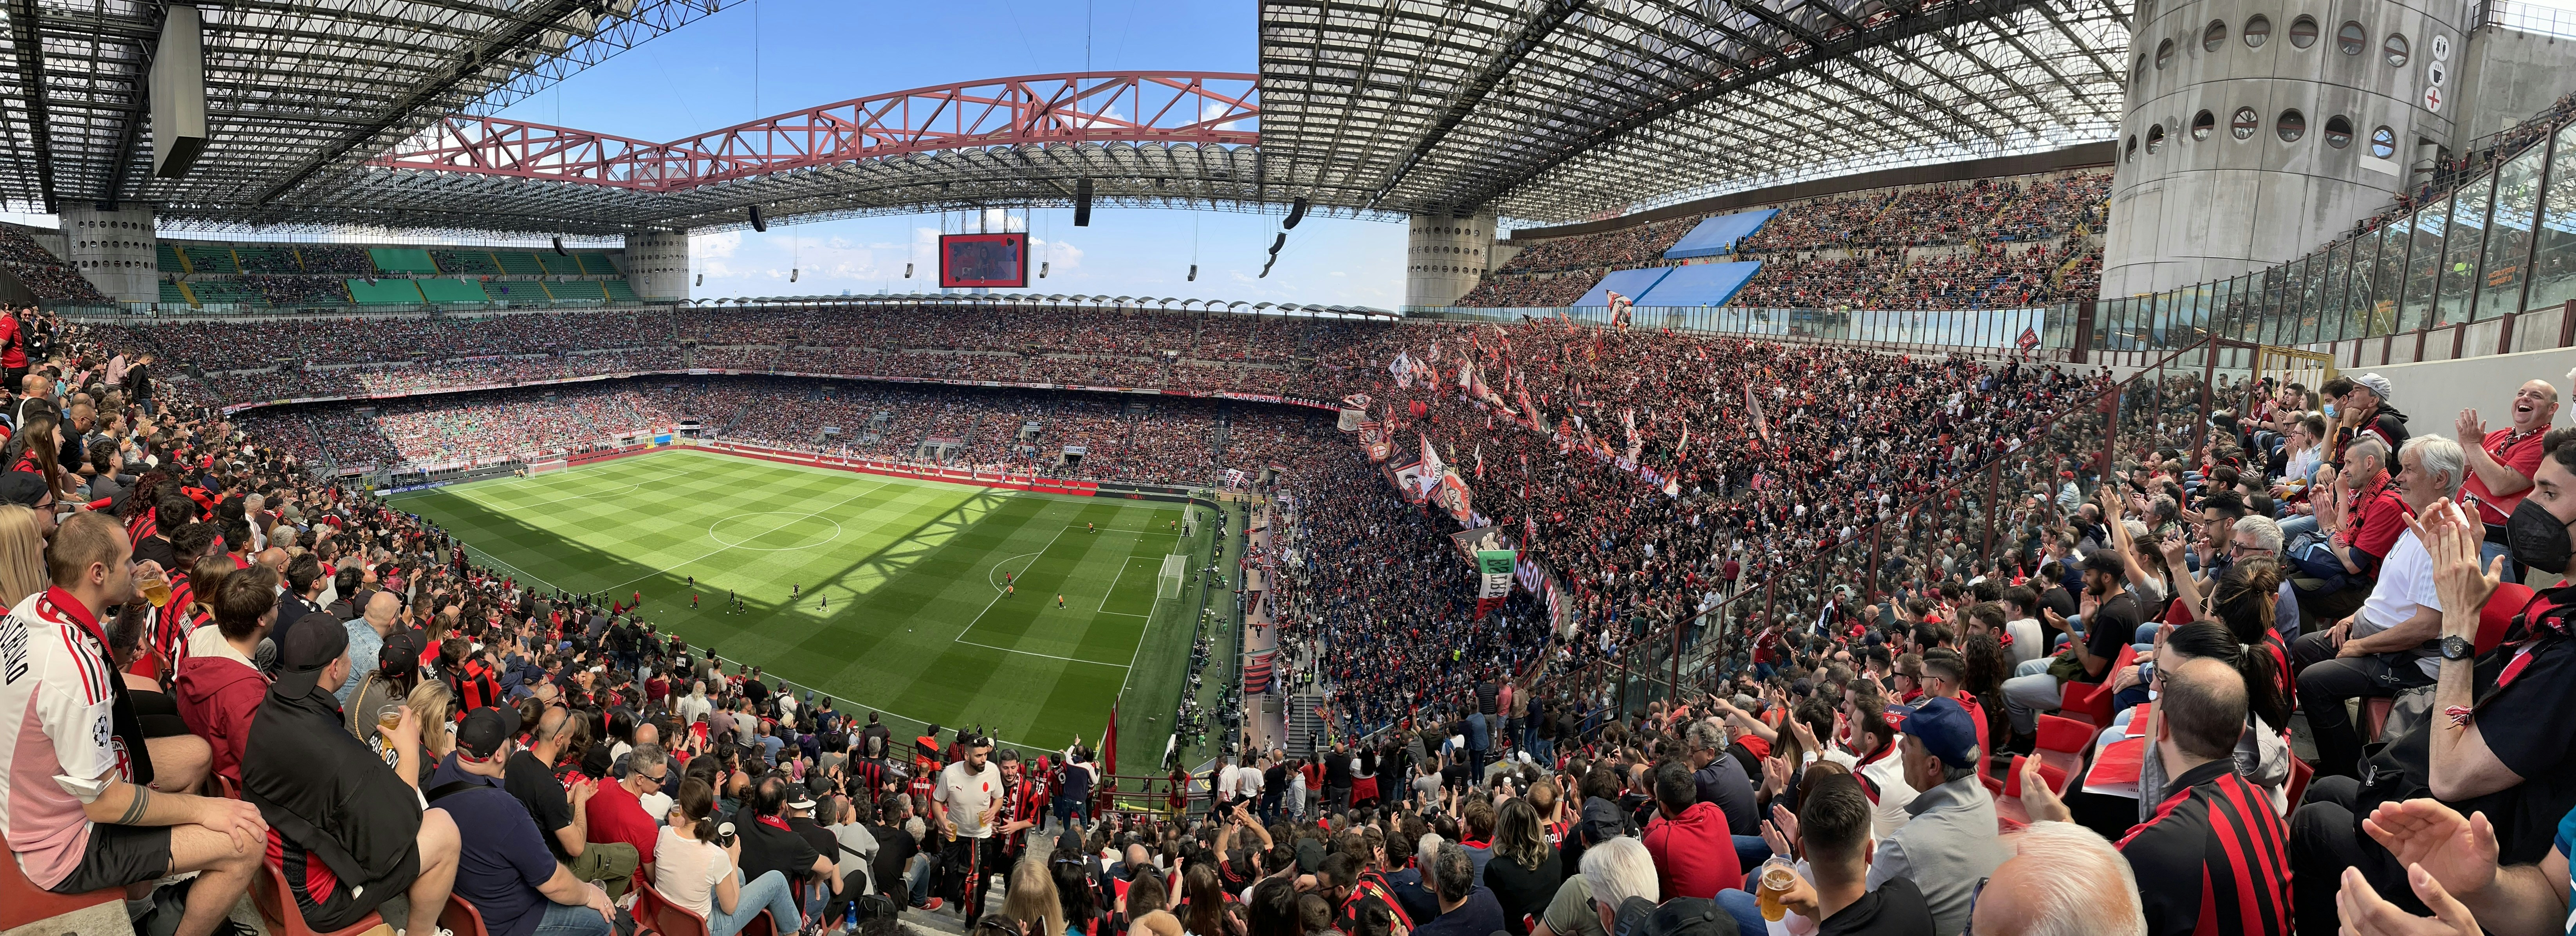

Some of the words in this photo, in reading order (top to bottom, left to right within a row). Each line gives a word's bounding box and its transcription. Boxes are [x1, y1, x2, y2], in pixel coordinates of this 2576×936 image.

[1224, 392, 1250, 401] MILAN
[1259, 395, 1281, 404] ISTRA
[1292, 398, 1320, 407] FOSSA
[1325, 402, 1338, 410] DEI
[454, 550, 458, 559] 13
[734, 683, 743, 696] 19
[1058, 773, 1066, 784] 9
[1035, 782, 1044, 795] 10
